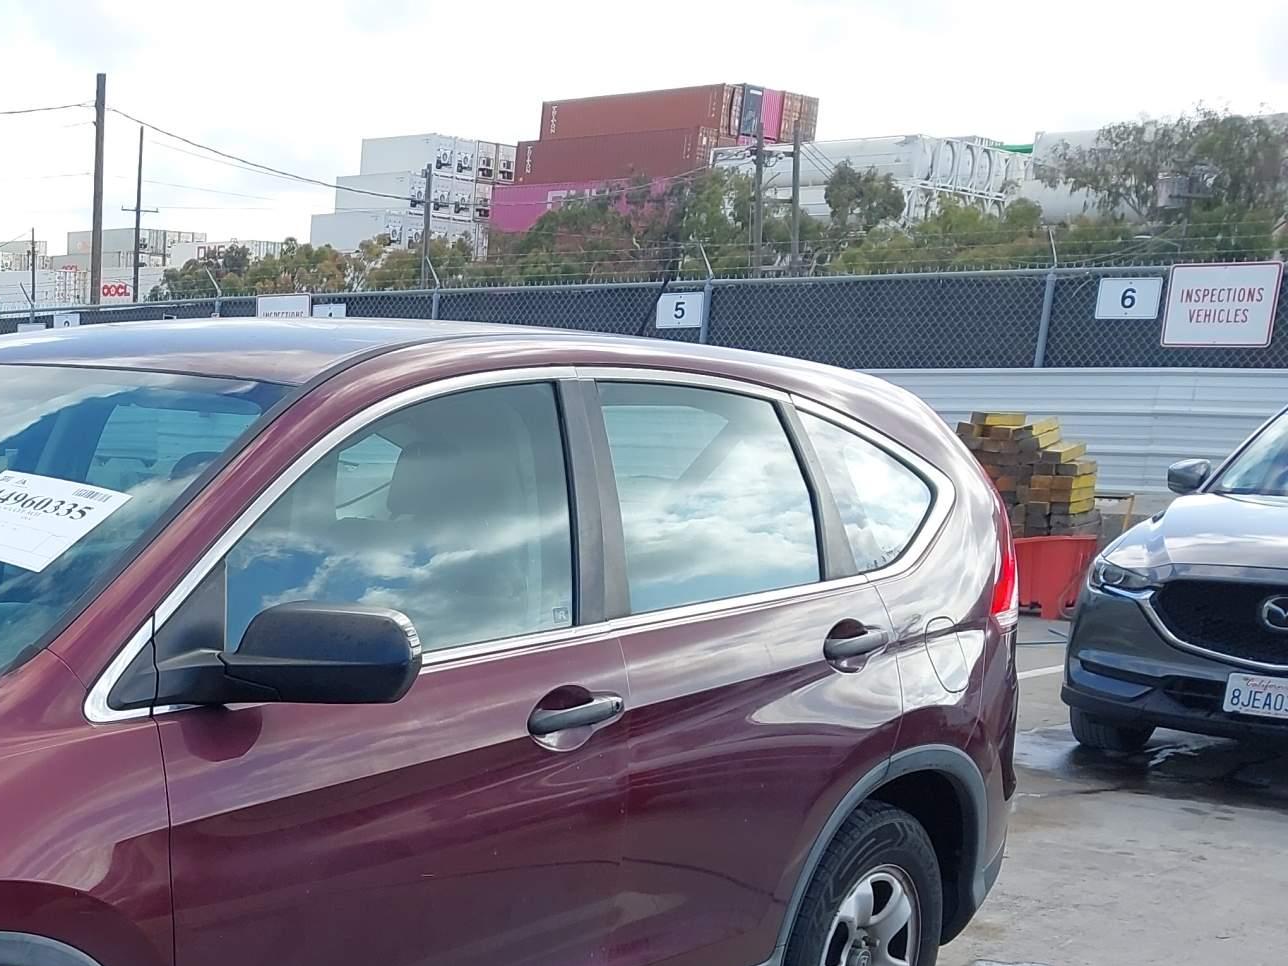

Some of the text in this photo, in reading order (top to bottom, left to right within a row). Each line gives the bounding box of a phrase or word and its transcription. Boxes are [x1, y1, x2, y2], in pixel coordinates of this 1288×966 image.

[102, 284, 130, 297] OOCL
[1120, 287, 1137, 309] 6
[1180, 287, 1265, 303] INSPECTIONS
[673, 301, 686, 319] 5
[1188, 308, 1249, 323] VEHICLES
[1231, 688, 1288, 712] 8JEA0
